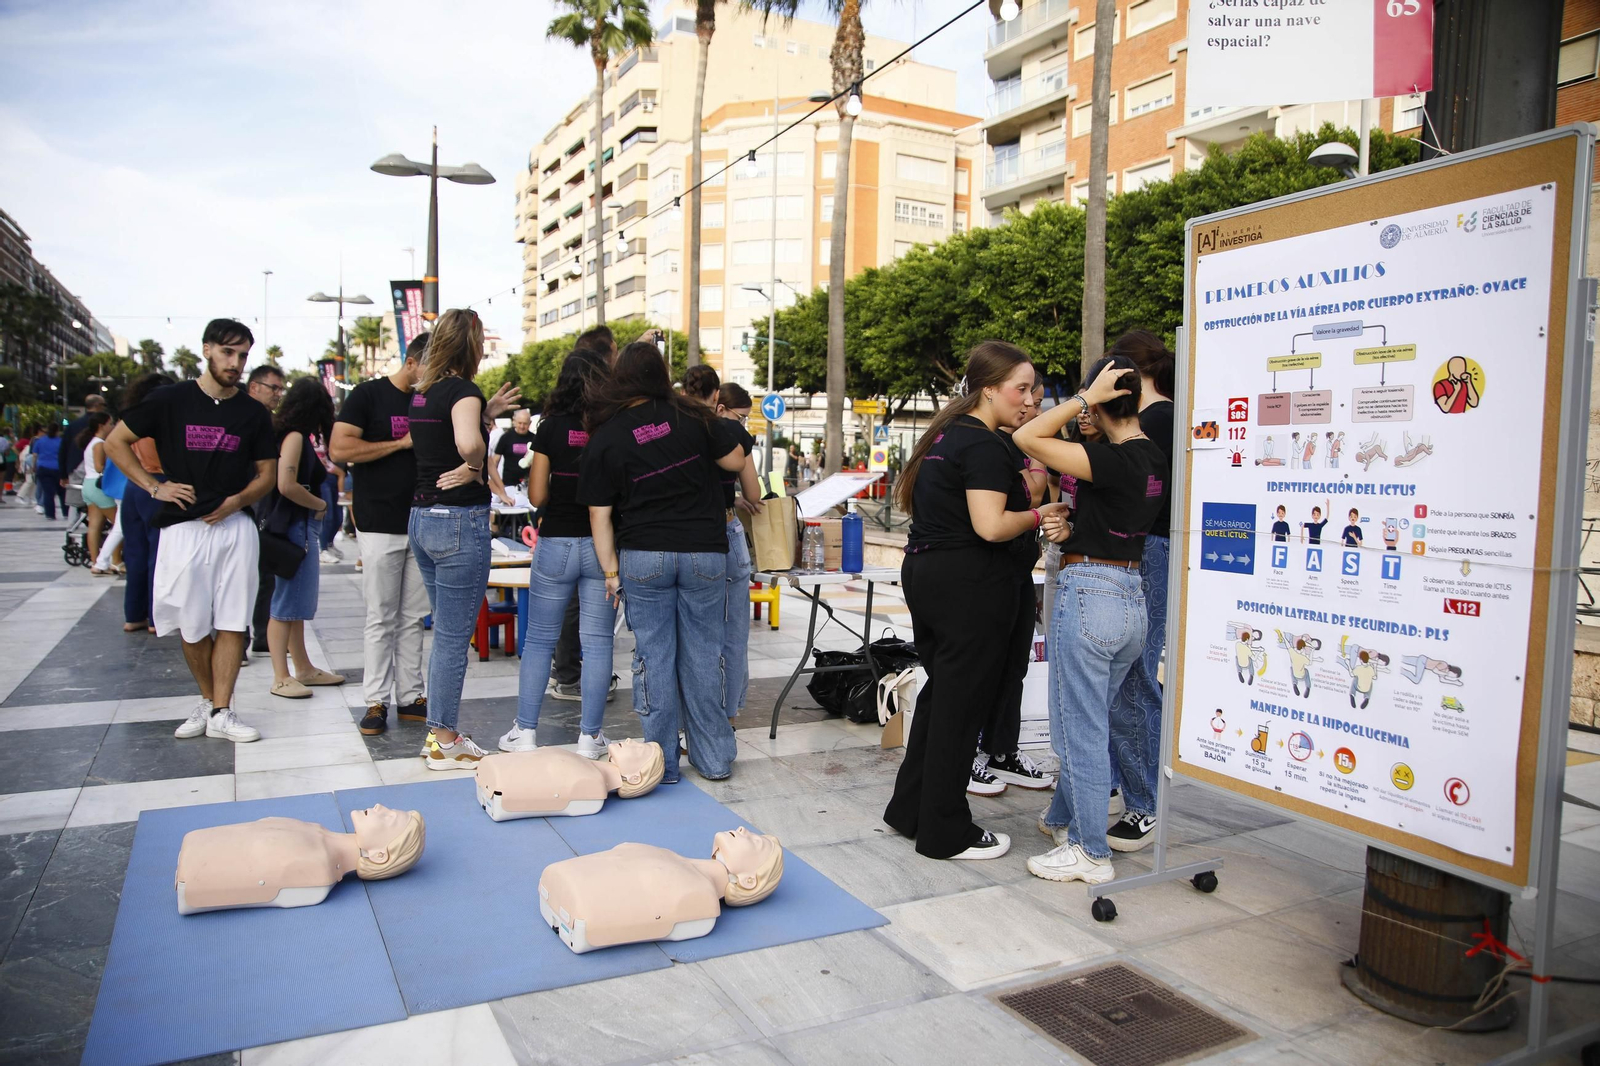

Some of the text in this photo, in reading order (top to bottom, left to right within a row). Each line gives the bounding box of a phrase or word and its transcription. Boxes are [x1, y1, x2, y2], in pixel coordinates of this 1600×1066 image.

[1208, 15, 1320, 27] salvar una nave
[1208, 34, 1270, 50] espacial?
[1482, 200, 1532, 215] FACULTAD DE
[1482, 207, 1532, 223] CIENCIAS DE
[1402, 220, 1448, 234] UNIVERSIDAD
[1482, 217, 1522, 230] LA SALUD
[1414, 227, 1448, 239] ALMERÍA
[1220, 232, 1262, 247] INVESTIGA
[1205, 261, 1385, 304] PRIMEROS AUXILIOS
[1204, 277, 1527, 331] OBSTRUCCIÓN DE LA VÍA AÉREA POR CUERPO EXTRAÑO: OVACE
[1337, 325, 1359, 334] gravedad
[1230, 410, 1246, 419] SOS
[1228, 427, 1246, 440] 112
[1267, 480, 1416, 496] IDENTIFICACIÓN DEL ICTUS
[1490, 511, 1515, 520] SONRÍA
[1205, 519, 1251, 529] SÉ MÁS RÁPIDO
[1227, 531, 1249, 539] ICTUS.
[1490, 531, 1516, 539] BRAZOS
[1428, 545, 1447, 554] Hágale
[1448, 547, 1483, 556] PREGUNTAS
[1275, 548, 1399, 577] F A S T
[1457, 579, 1484, 588] síntomas
[1457, 604, 1476, 614] 112
[1237, 600, 1449, 641] POSICIÓN LATERAL DE SEGURIDAD: PLS
[1250, 699, 1410, 749] MANEJO DE LA HIPOGLUCEMIA
[1215, 742, 1235, 752] primeros
[1204, 751, 1226, 763] BAJÓN
[1252, 766, 1271, 775] glucosa
[1287, 762, 1307, 772] Esperar
[1294, 773, 1308, 783] min.
[1342, 778, 1369, 790] mejorado
[1320, 785, 1337, 795] repetir
[1345, 792, 1366, 803] ingesta
[1333, 782, 1359, 794] situación
